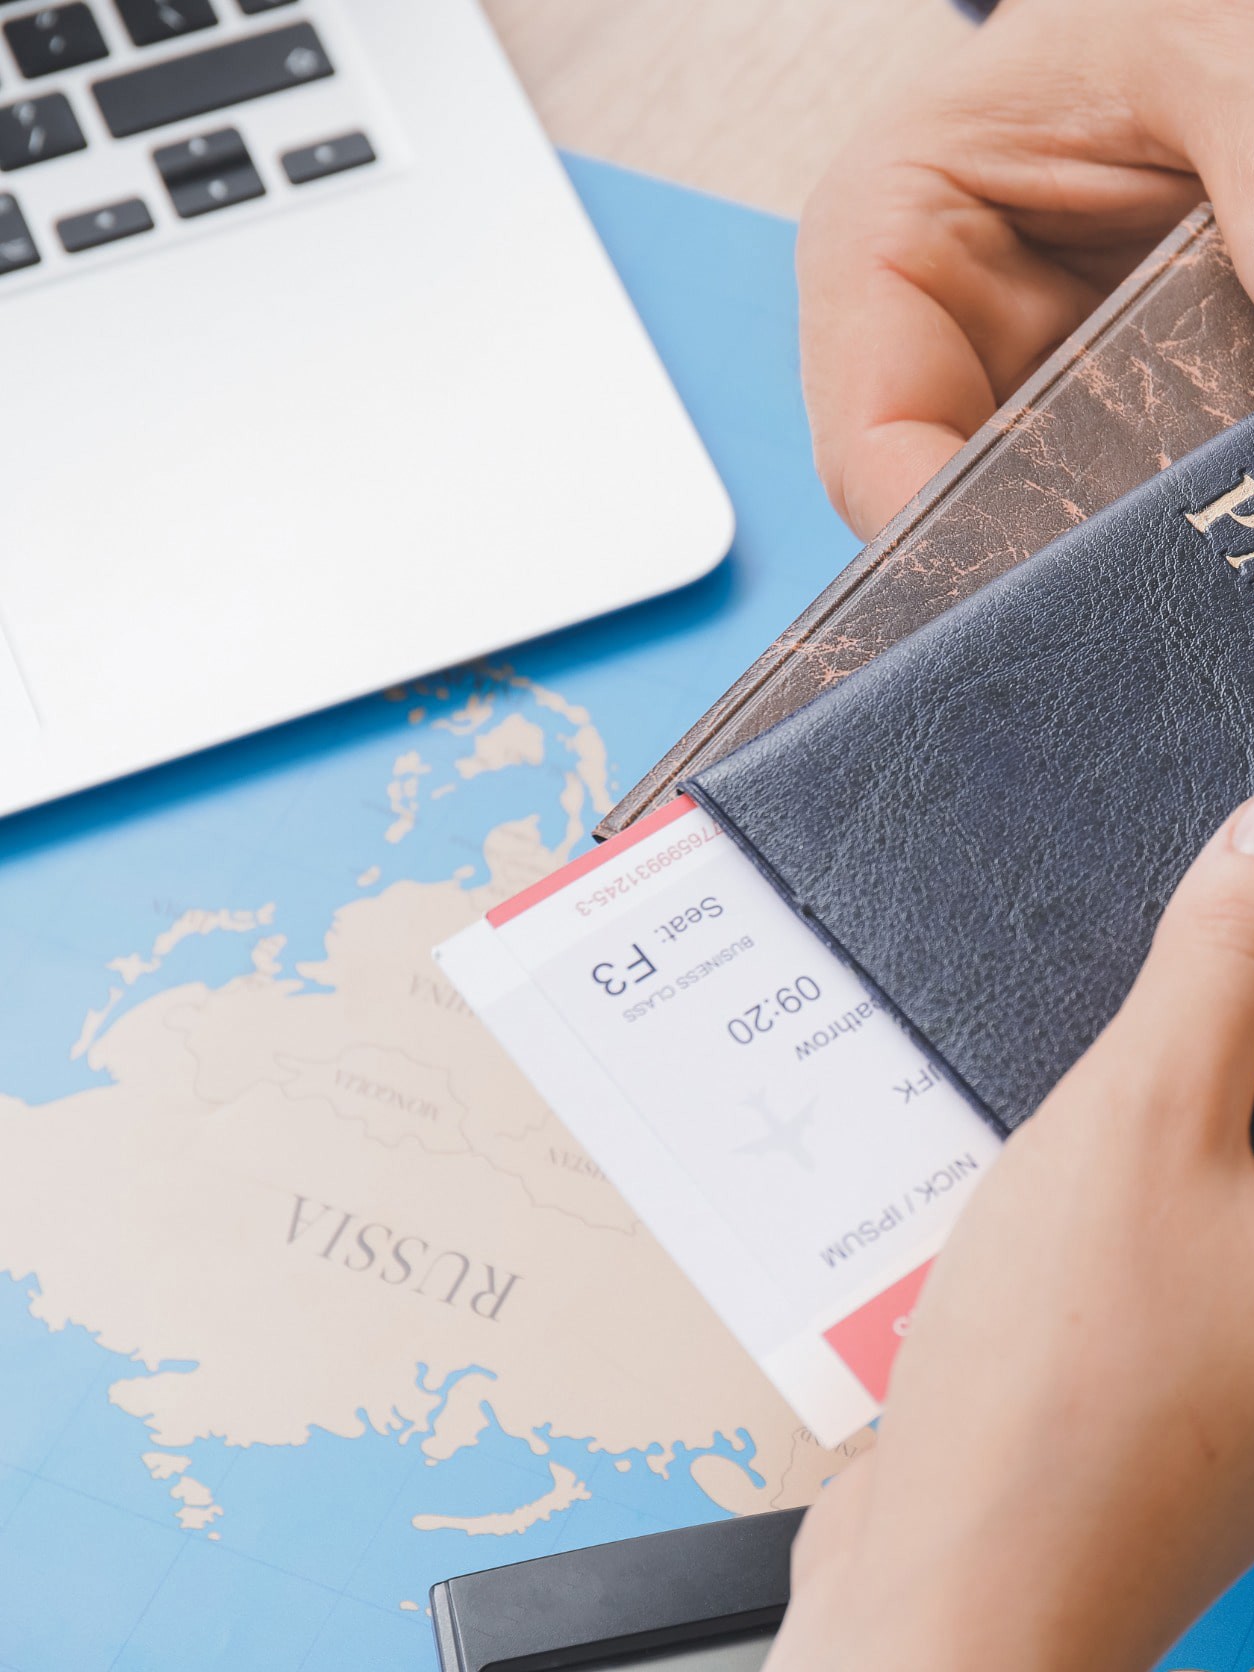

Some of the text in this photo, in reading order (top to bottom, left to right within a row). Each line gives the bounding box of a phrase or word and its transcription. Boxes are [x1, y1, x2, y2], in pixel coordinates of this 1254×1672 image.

[591, 896, 724, 997] Seat: F3
[622, 935, 755, 1023] BUSINESS CLASS
[727, 975, 821, 1046] 09:20
[334, 1069, 438, 1122] MONGOLIA
[913, 1152, 979, 1205] NICK
[286, 1193, 525, 1322] RUSSIA
[820, 1204, 904, 1268] IPSUM
